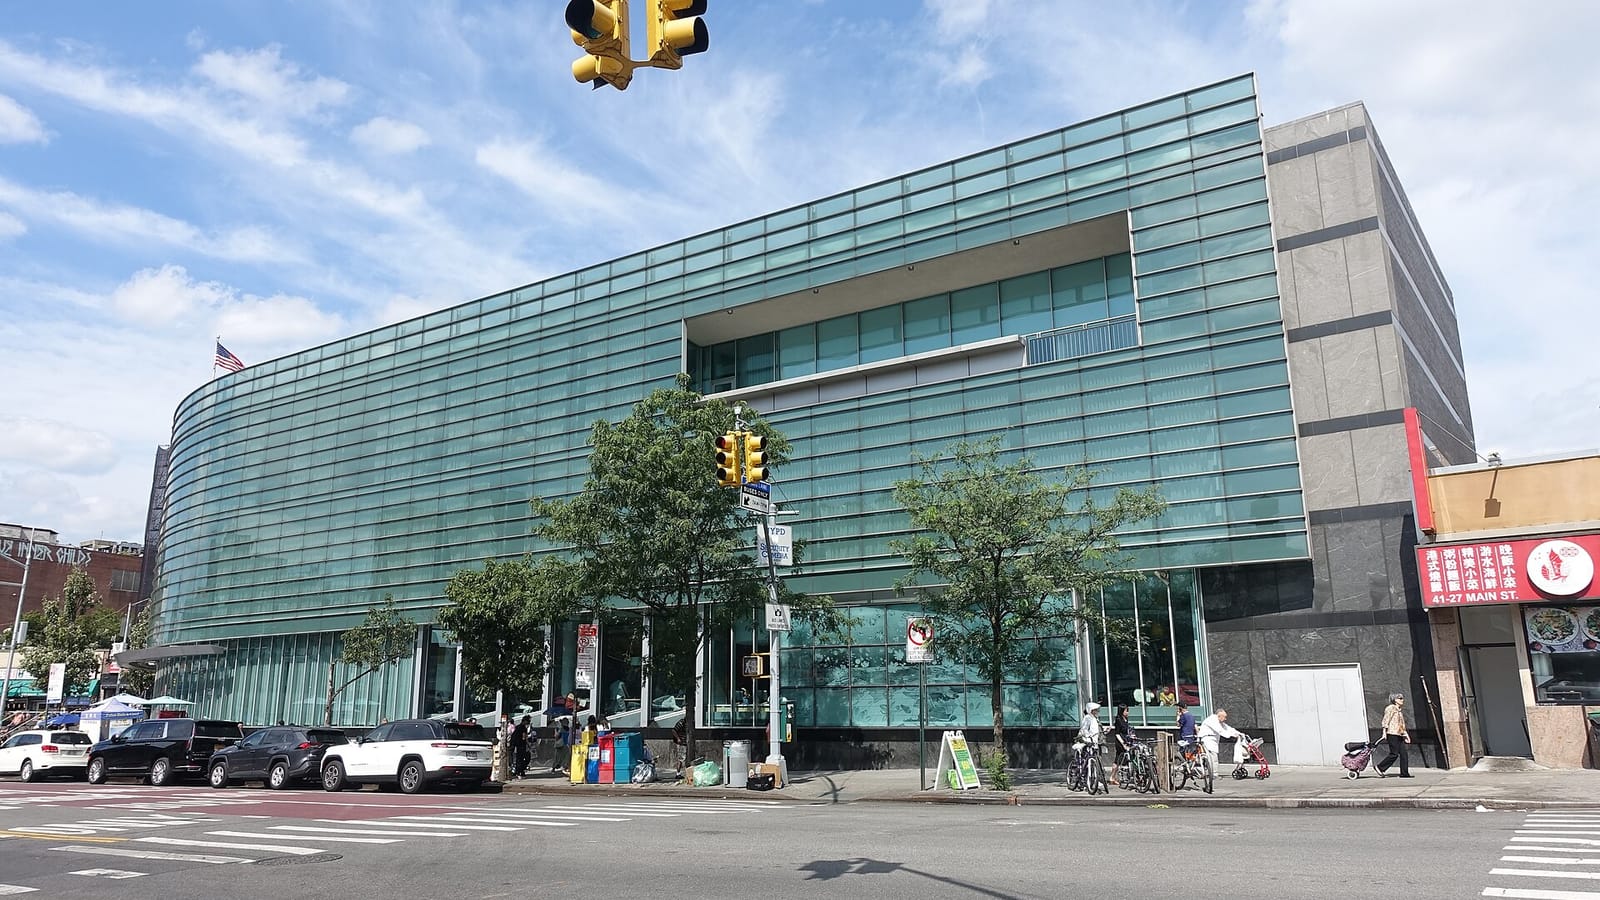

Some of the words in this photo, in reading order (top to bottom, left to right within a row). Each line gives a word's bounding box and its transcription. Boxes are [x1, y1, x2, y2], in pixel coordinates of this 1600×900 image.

[767, 527, 786, 535] YPD
[18, 542, 54, 562] INNER
[56, 547, 92, 567] CHILDS
[1432, 594, 1463, 604] 41-27
[1465, 592, 1497, 602] MAIN
[1500, 590, 1519, 600] ST.
